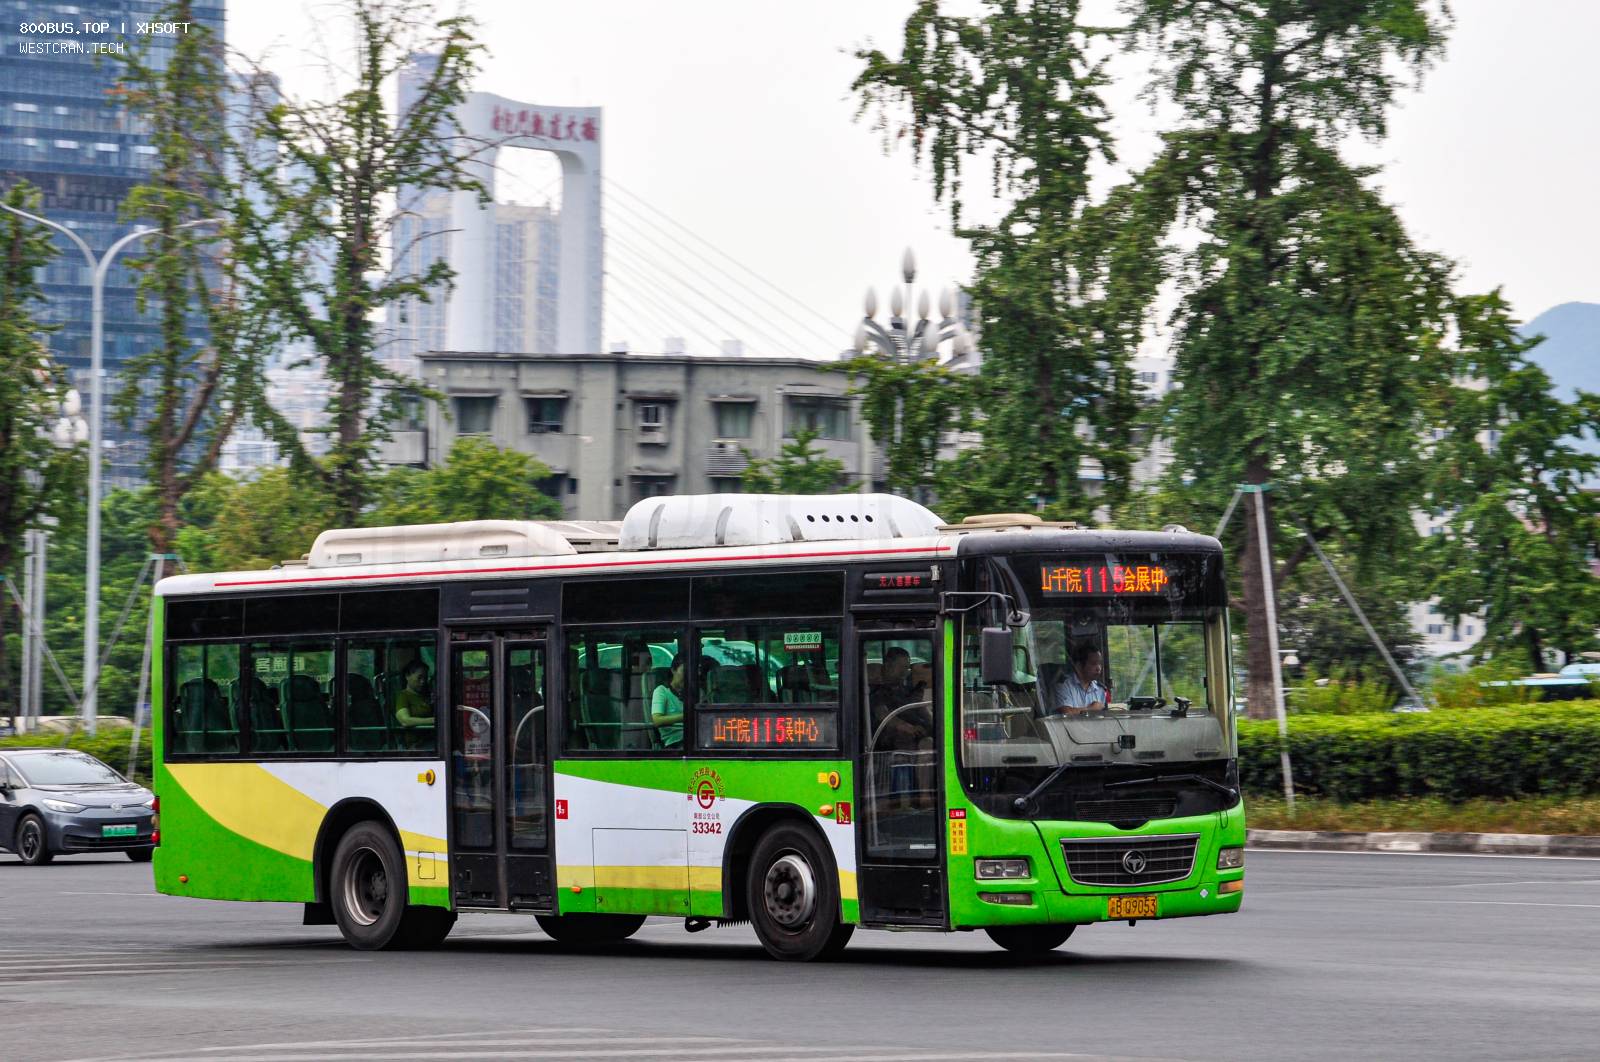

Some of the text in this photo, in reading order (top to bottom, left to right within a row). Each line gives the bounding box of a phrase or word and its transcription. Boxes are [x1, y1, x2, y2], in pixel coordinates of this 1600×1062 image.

[1084, 566, 1125, 593] 115
[1124, 566, 1168, 593] 会展中
[752, 717, 786, 743] 115
[692, 821, 722, 834] 33342
